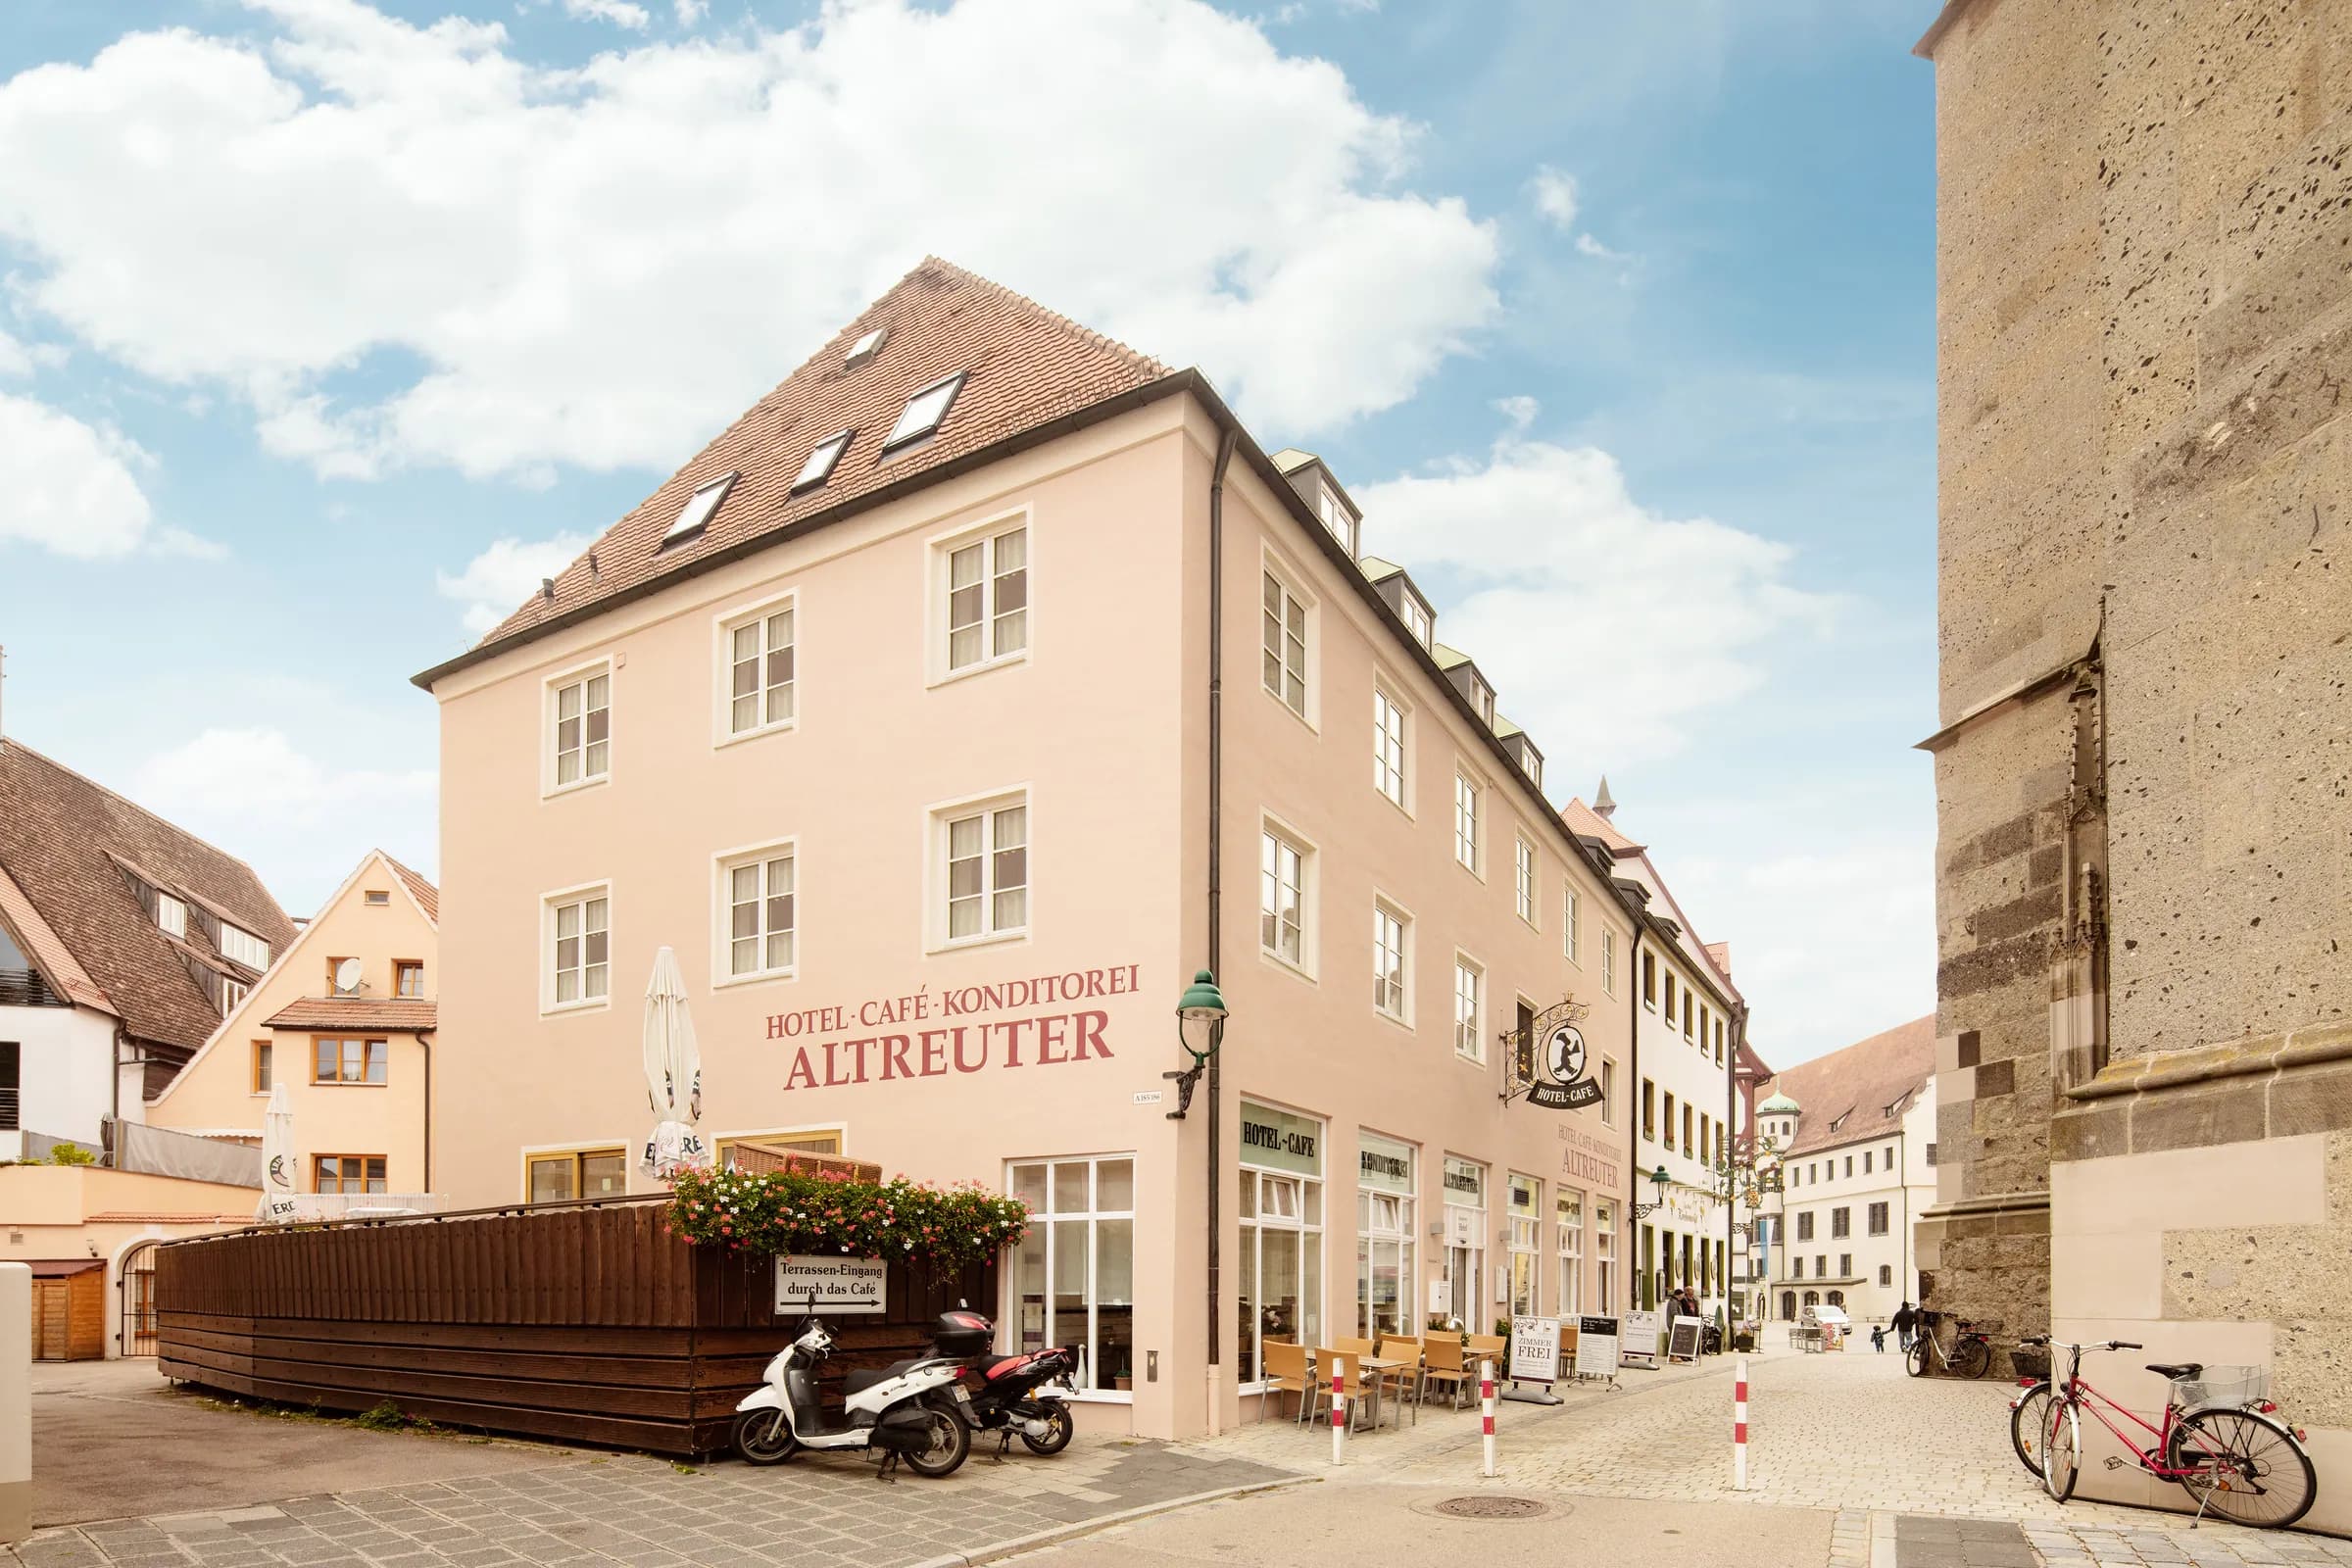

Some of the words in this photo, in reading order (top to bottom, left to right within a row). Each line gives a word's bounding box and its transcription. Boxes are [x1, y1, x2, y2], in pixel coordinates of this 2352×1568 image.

[784, 1009, 1115, 1091] ALTREUTER
[1537, 1085, 1593, 1102] HOTEL-CAFE
[1562, 1147, 1618, 1190] ALTREUTER
[780, 1261, 883, 1279] Terrassen-Eingang
[787, 1281, 823, 1295] durch
[826, 1282, 847, 1295] das
[1518, 1337, 1552, 1348] ZIMMER
[1518, 1346, 1552, 1359] FREI
